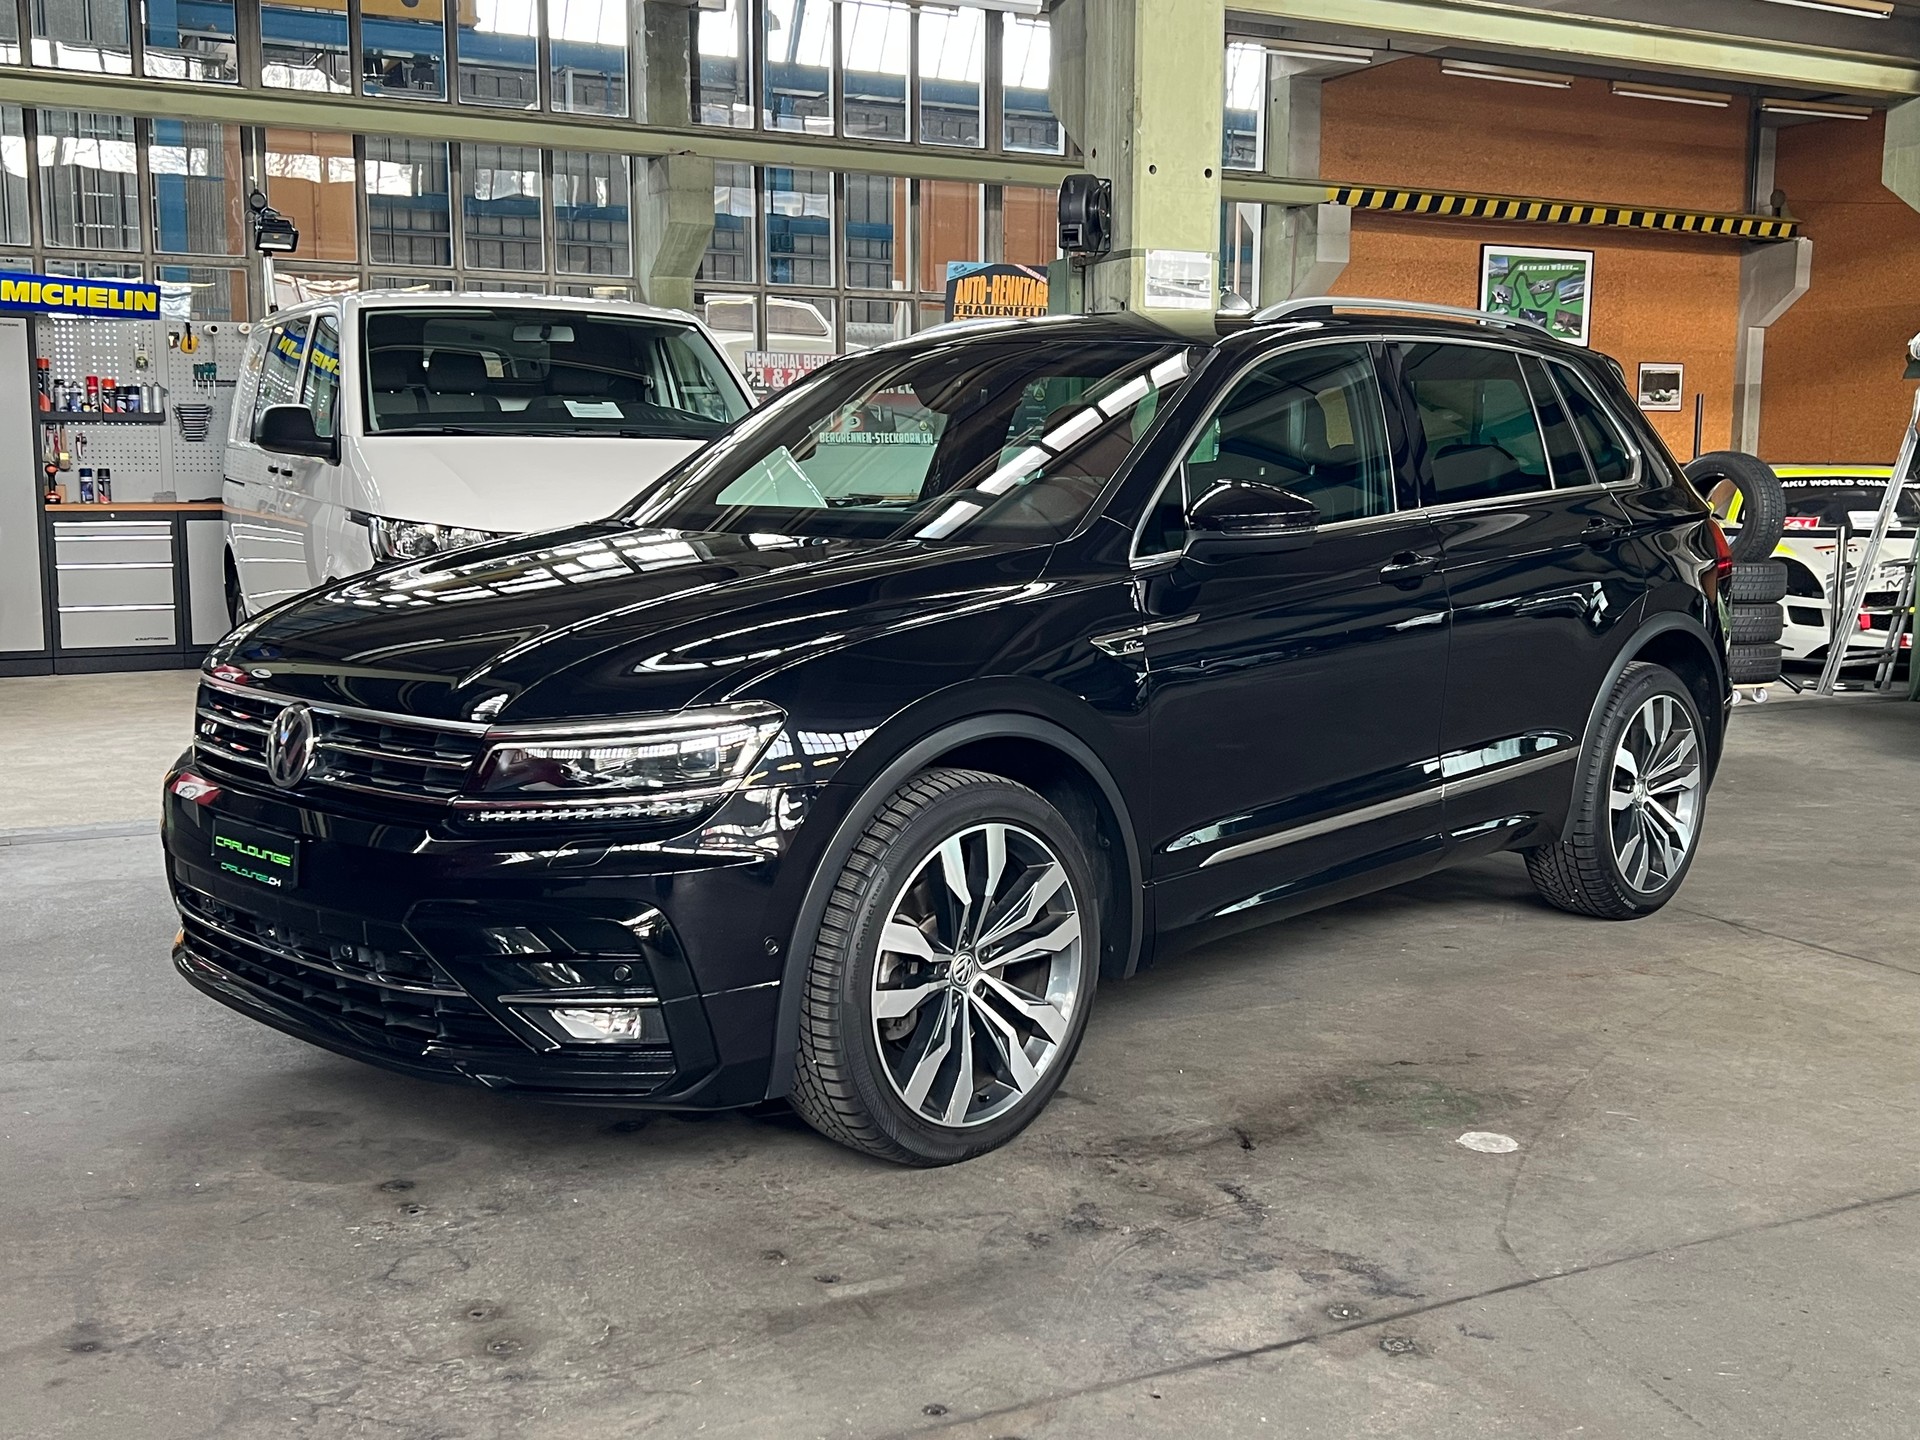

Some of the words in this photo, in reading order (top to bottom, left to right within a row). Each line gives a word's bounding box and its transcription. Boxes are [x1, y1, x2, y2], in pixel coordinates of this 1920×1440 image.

[1, 280, 156, 312] MICHELIN
[955, 304, 1047, 317] FRAUENFELD
[747, 352, 802, 369] MEMORIAL
[819, 432, 934, 444] BERGRENNEN-STECKBORN.CH
[1780, 480, 1806, 488] AKU
[1810, 479, 1854, 487] WORLD
